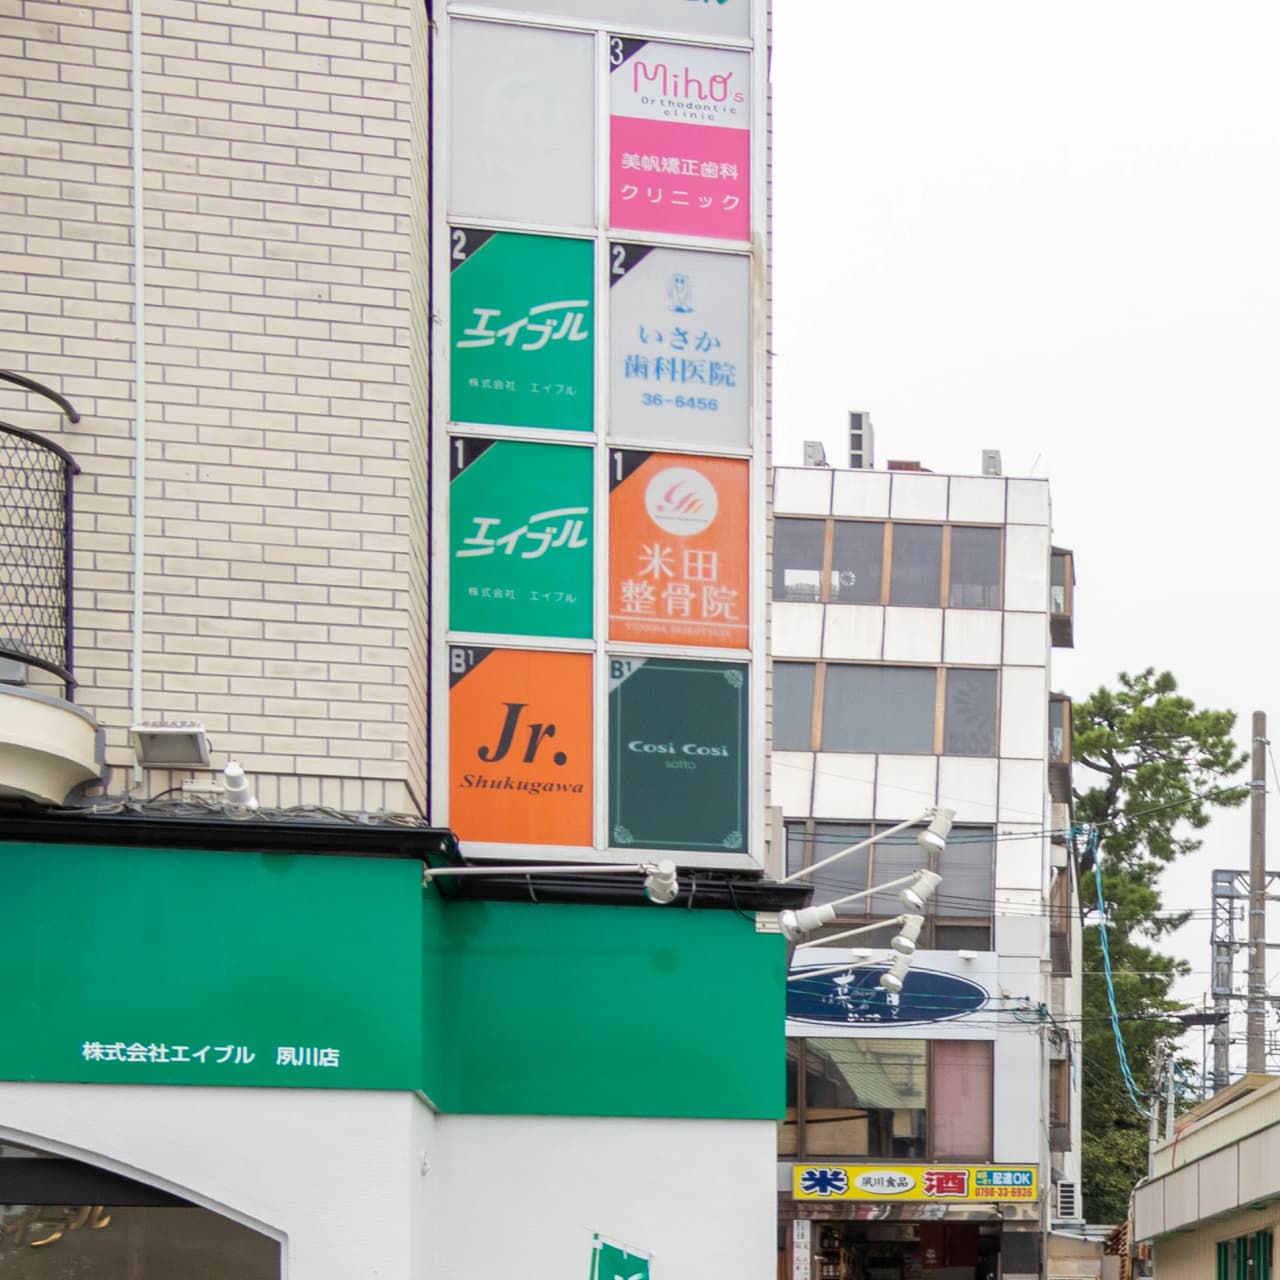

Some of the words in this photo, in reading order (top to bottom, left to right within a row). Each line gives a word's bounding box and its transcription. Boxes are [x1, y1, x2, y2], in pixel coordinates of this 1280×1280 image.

[610, 38, 624, 65] 3
[641, 96, 737, 114] Orthodontic
[663, 109, 715, 121] clinic
[620, 153, 739, 181] 美帆矯正歯科
[620, 184, 740, 211] クリニック
[452, 230, 467, 260] 2
[611, 245, 626, 275] 2
[456, 300, 590, 351] エイブル
[638, 325, 721, 352] いさか
[624, 354, 737, 388] 歯科医院
[641, 392, 719, 411] 36-6456
[454, 439, 465, 470] 1
[613, 451, 624, 481] 1
[456, 507, 589, 559] エイブル
[637, 543, 719, 583] 米田
[620, 578, 741, 621] 整骨院
[477, 702, 568, 766] Jr.
[459, 774, 585, 796] Shukugawa
[82, 1041, 256, 1064] 株式会社エイブル
[276, 1046, 340, 1067] 夙川店
[800, 1168, 847, 1195] 米
[923, 1170, 968, 1195] 酒
